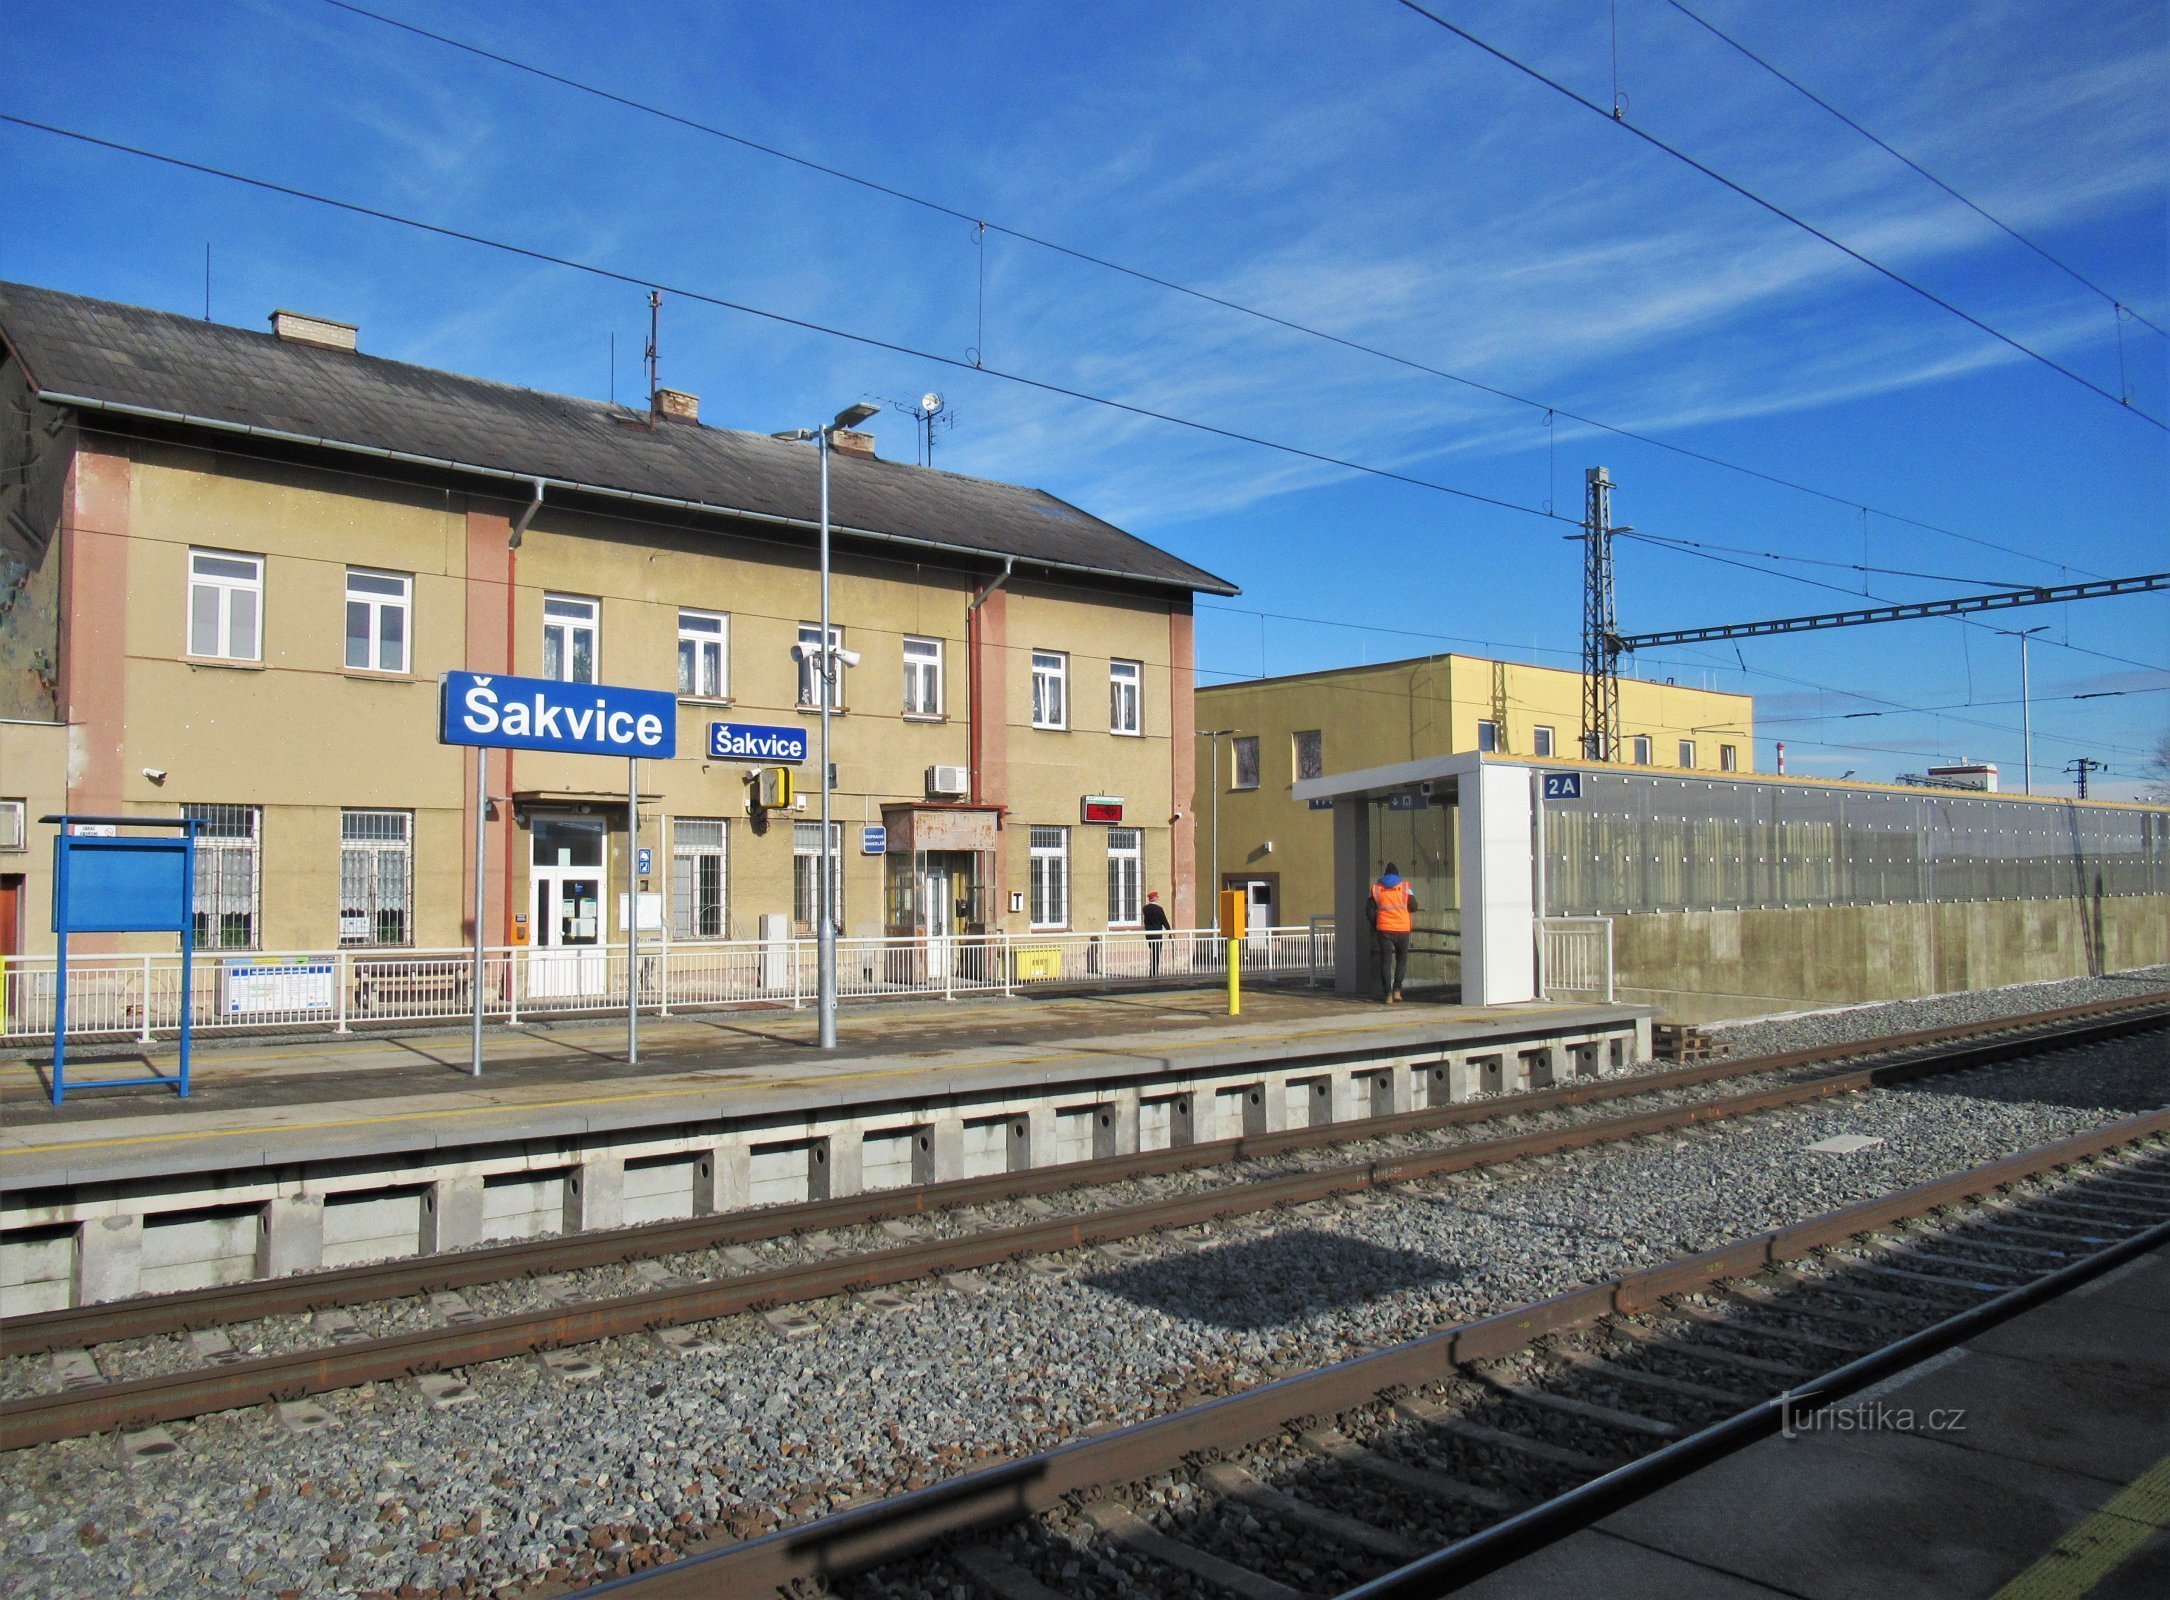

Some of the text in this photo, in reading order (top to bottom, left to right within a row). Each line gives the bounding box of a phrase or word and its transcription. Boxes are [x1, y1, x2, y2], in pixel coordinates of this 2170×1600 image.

[463, 675, 663, 746] Šakvice
[716, 725, 802, 757] Šakvice
[1013, 893, 1022, 910] T
